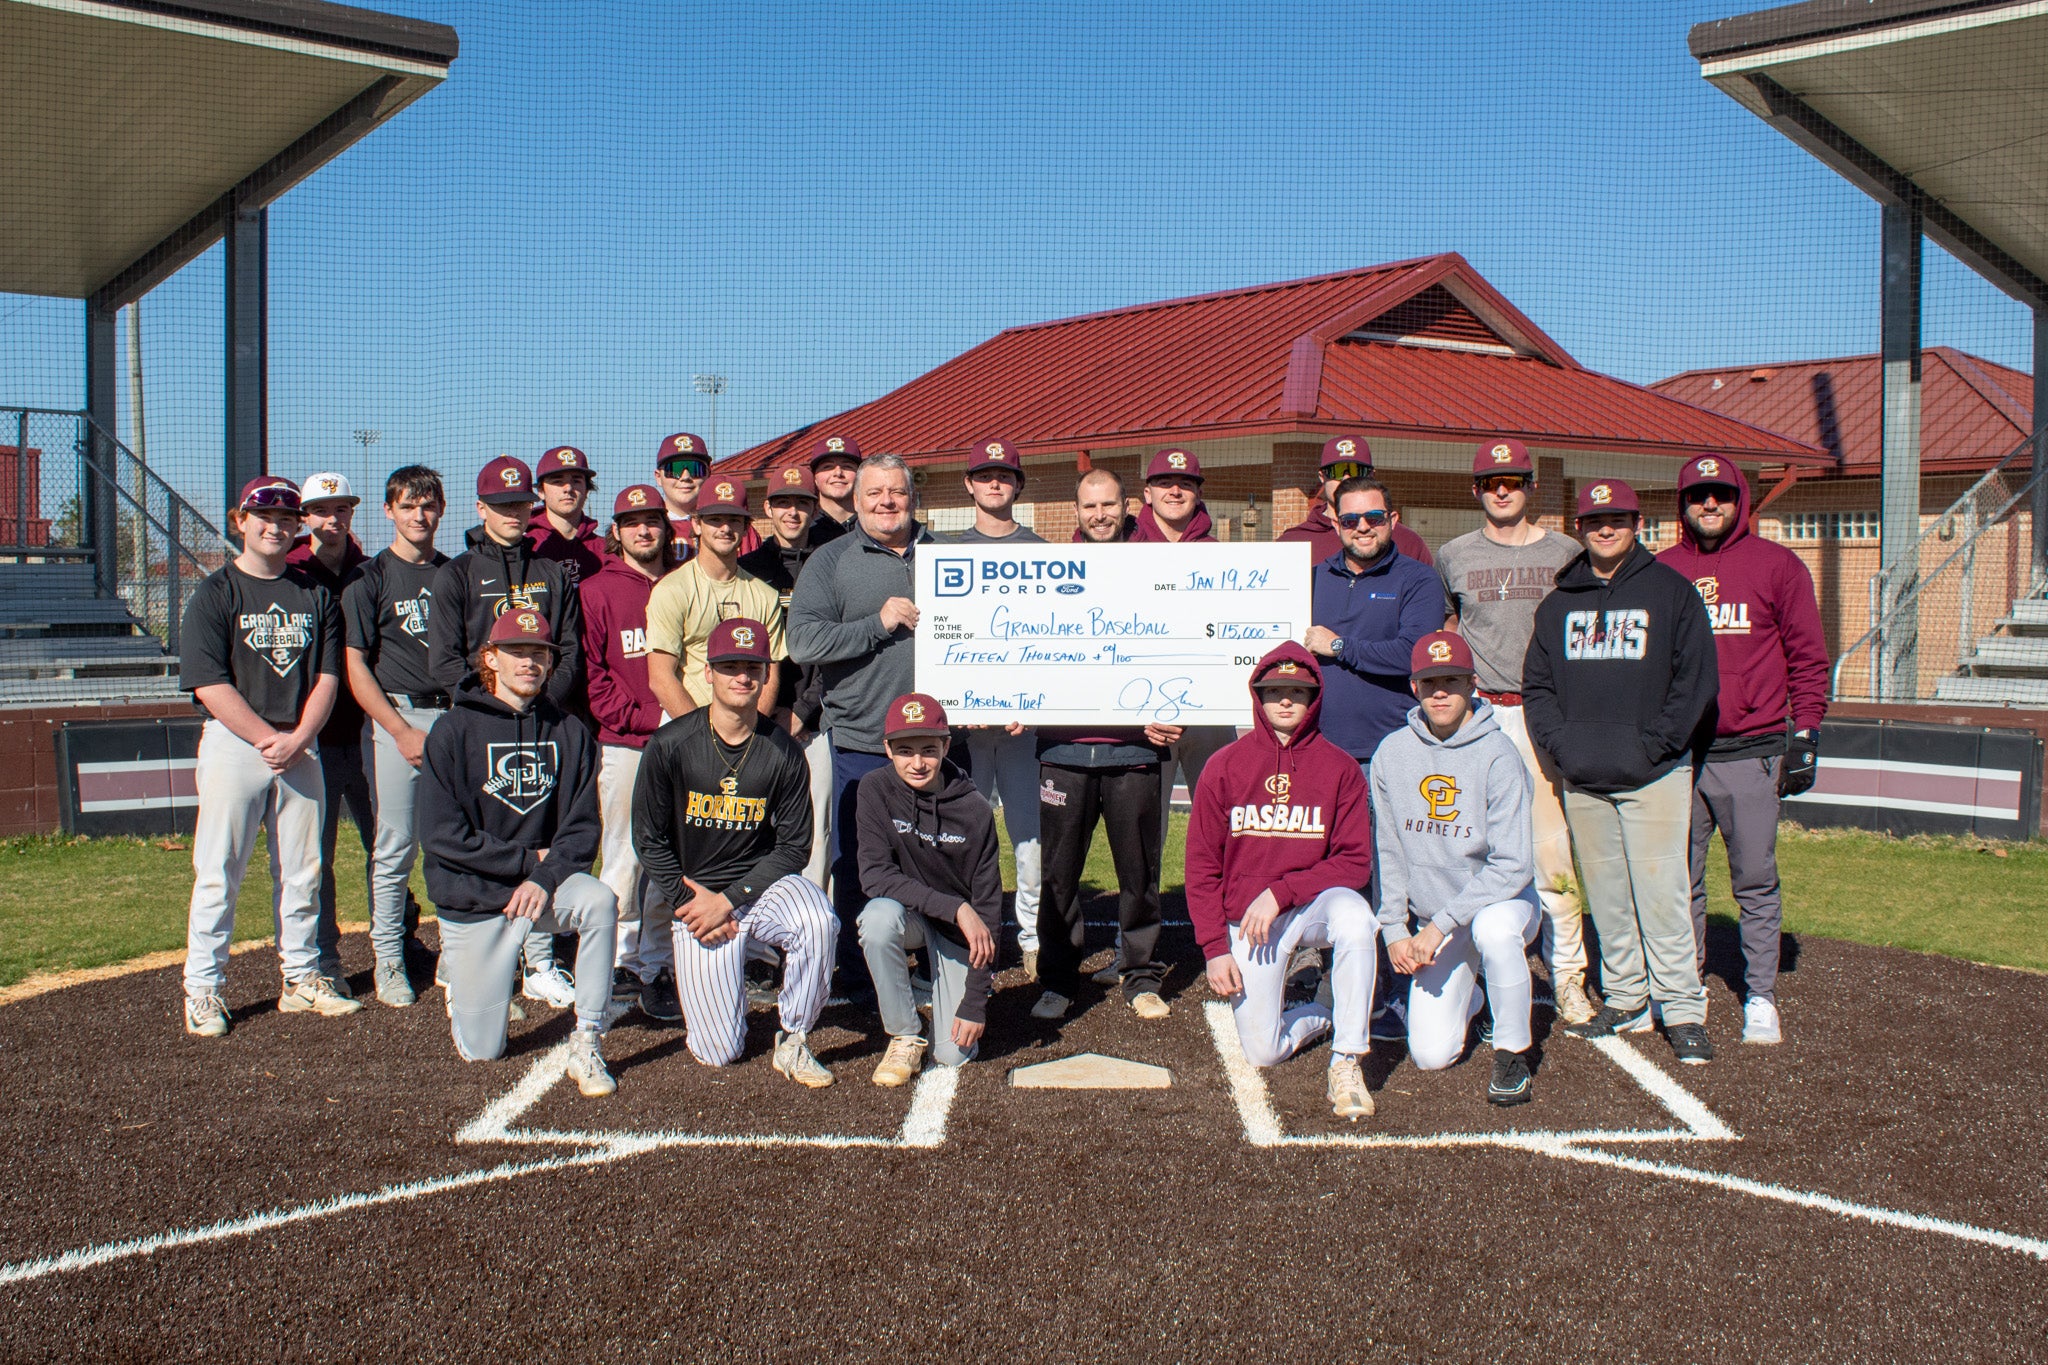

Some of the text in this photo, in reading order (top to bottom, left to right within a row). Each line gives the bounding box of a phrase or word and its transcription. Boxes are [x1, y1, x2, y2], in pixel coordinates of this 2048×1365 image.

[982, 560, 1086, 580] BOLTON
[1221, 568, 1242, 591] 19,
[1246, 568, 1269, 589] 24
[1467, 566, 1555, 590] GRAND LAKE
[982, 585, 1046, 594] FORD
[1154, 583, 1177, 591] DATE
[239, 613, 313, 629] GRAND LAKE
[1705, 603, 1751, 629] BALL
[256, 633, 303, 645] BASEBALL
[934, 632, 975, 640] ORDER OF
[1206, 623, 1215, 638] $
[1564, 609, 1650, 660] GLHS
[686, 791, 767, 822] HORNETS
[1405, 818, 1473, 839] HORNETS
